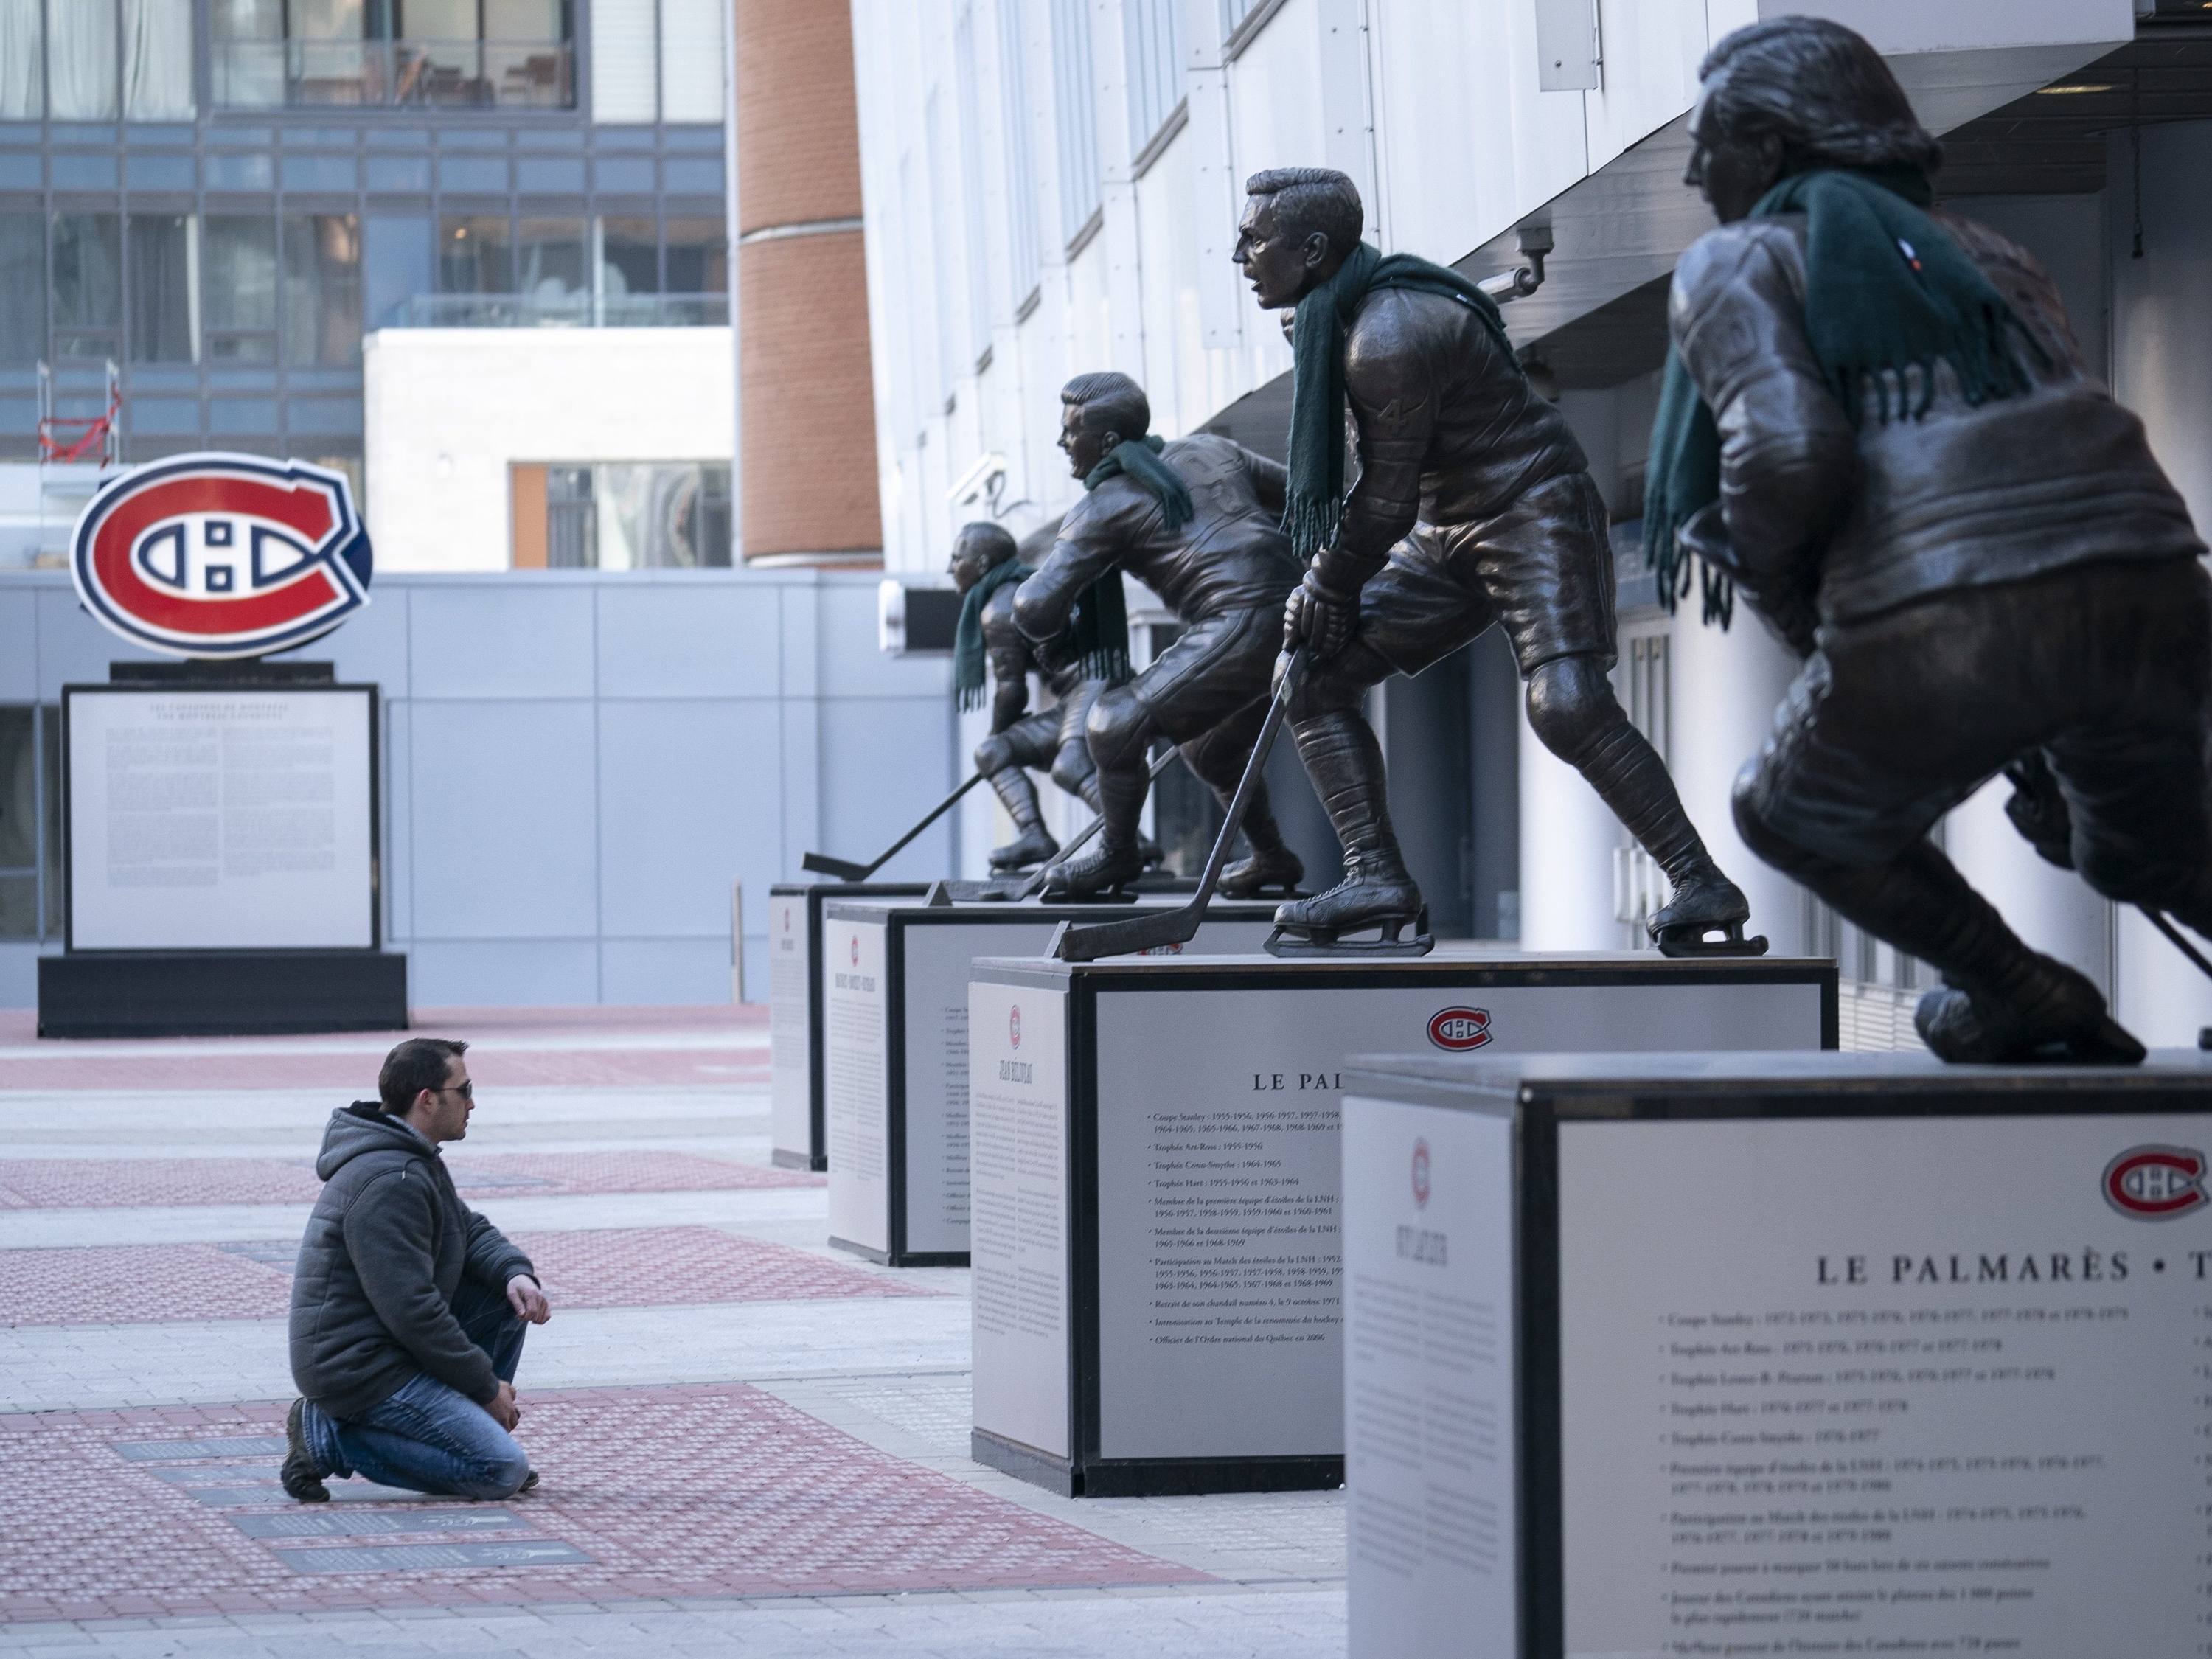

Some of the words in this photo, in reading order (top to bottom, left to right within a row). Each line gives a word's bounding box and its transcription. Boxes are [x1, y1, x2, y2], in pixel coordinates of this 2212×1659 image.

[1253, 1074, 1284, 1091] LE
[1298, 1073, 1345, 1090] PAL
[1322, 1254, 1342, 1264] 1952-
[1817, 1254, 1868, 1284] LE
[1892, 1245, 2129, 1284] PALMARÈS
[2188, 1250, 2212, 1280] T
